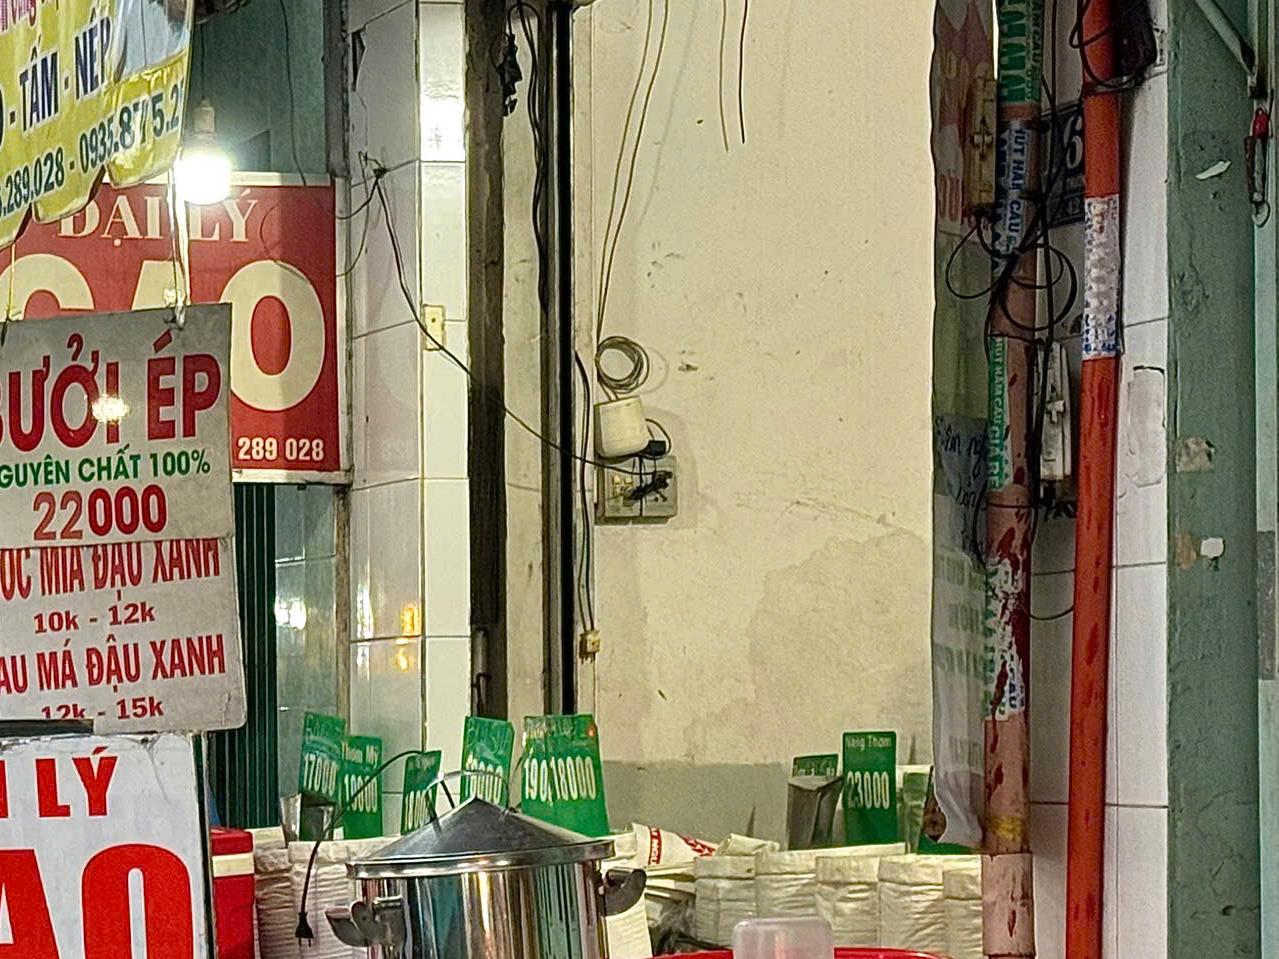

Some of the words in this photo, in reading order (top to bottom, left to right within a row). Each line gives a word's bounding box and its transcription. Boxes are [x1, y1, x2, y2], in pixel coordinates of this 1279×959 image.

[147, 328, 222, 442] ÉP
[78, 443, 142, 483] CHẤT
[149, 449, 211, 478] 100%
[236, 436, 280, 461] 289
[284, 436, 327, 461] 028
[32, 484, 168, 542] 22000
[33, 610, 79, 634] 10k
[108, 601, 156, 627] 12k
[36, 638, 79, 692] MÁ
[86, 633, 142, 694] ĐẬU
[150, 633, 226, 682] XANH
[115, 695, 164, 720] 15k
[34, 746, 119, 819] LÝ
